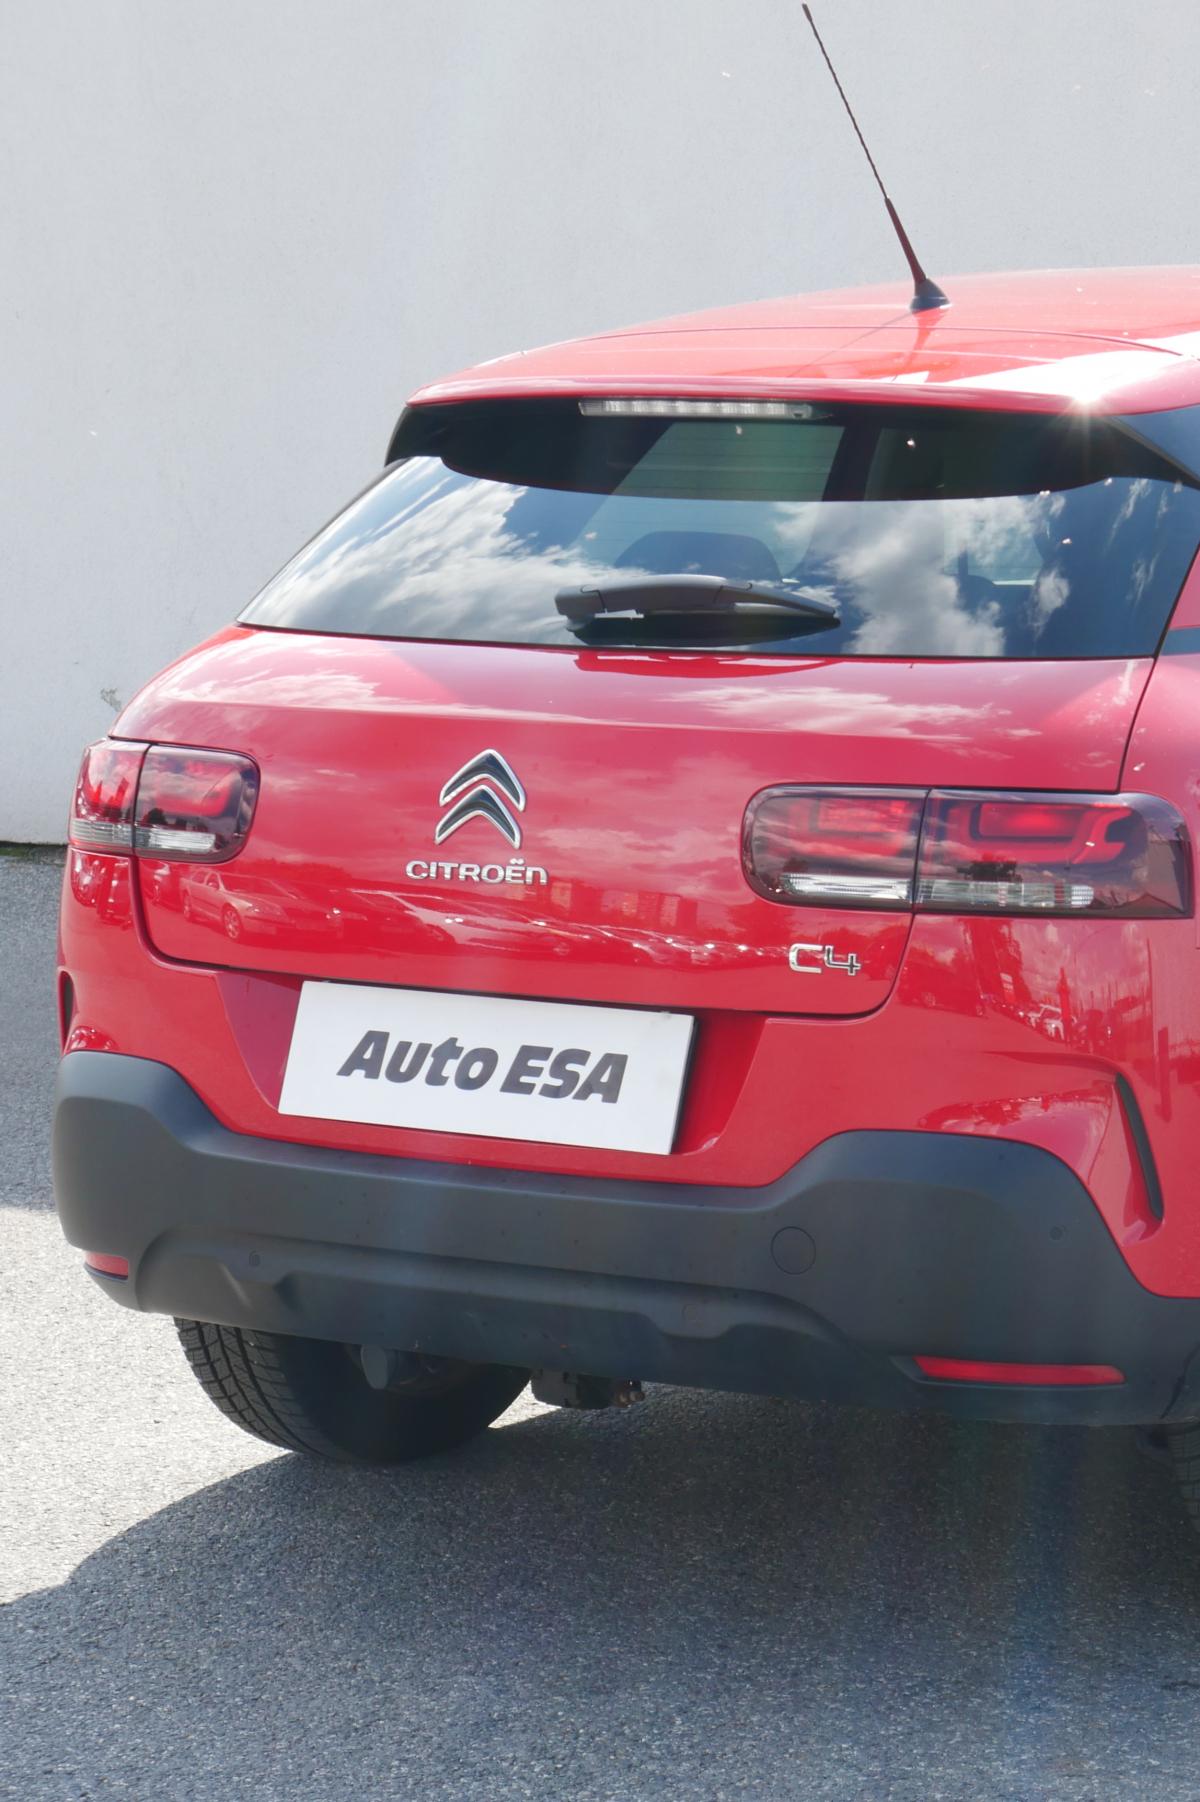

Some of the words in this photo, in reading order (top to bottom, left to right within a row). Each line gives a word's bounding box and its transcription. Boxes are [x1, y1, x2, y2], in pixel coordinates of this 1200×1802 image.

[789, 943, 861, 976] C4
[337, 1030, 499, 1091] Auto
[500, 1045, 628, 1104] ESA
